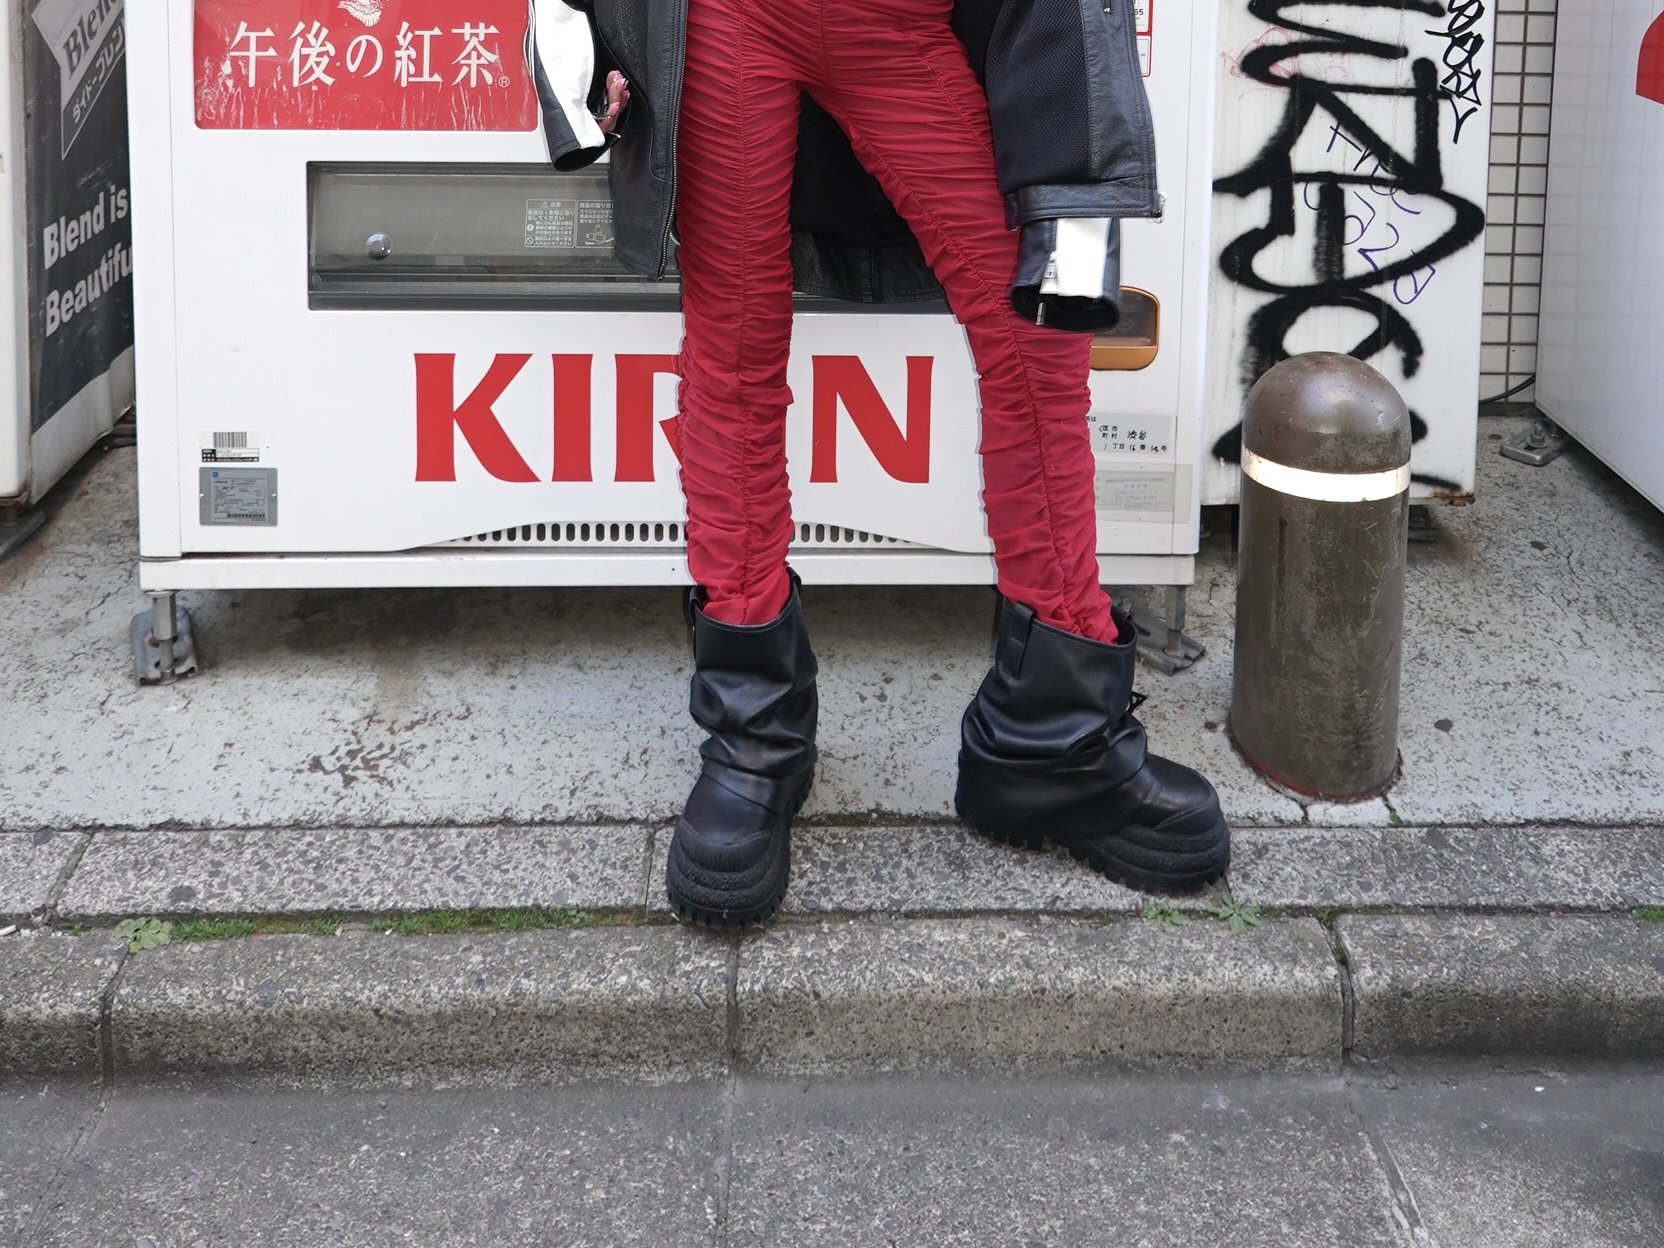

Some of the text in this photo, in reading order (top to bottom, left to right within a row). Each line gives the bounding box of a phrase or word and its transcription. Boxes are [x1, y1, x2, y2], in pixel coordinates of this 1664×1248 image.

[228, 20, 501, 88] 午後の紅茶
[43, 185, 128, 270] Blend is
[45, 245, 133, 338] Beautifu
[414, 353, 934, 484] KIRN
